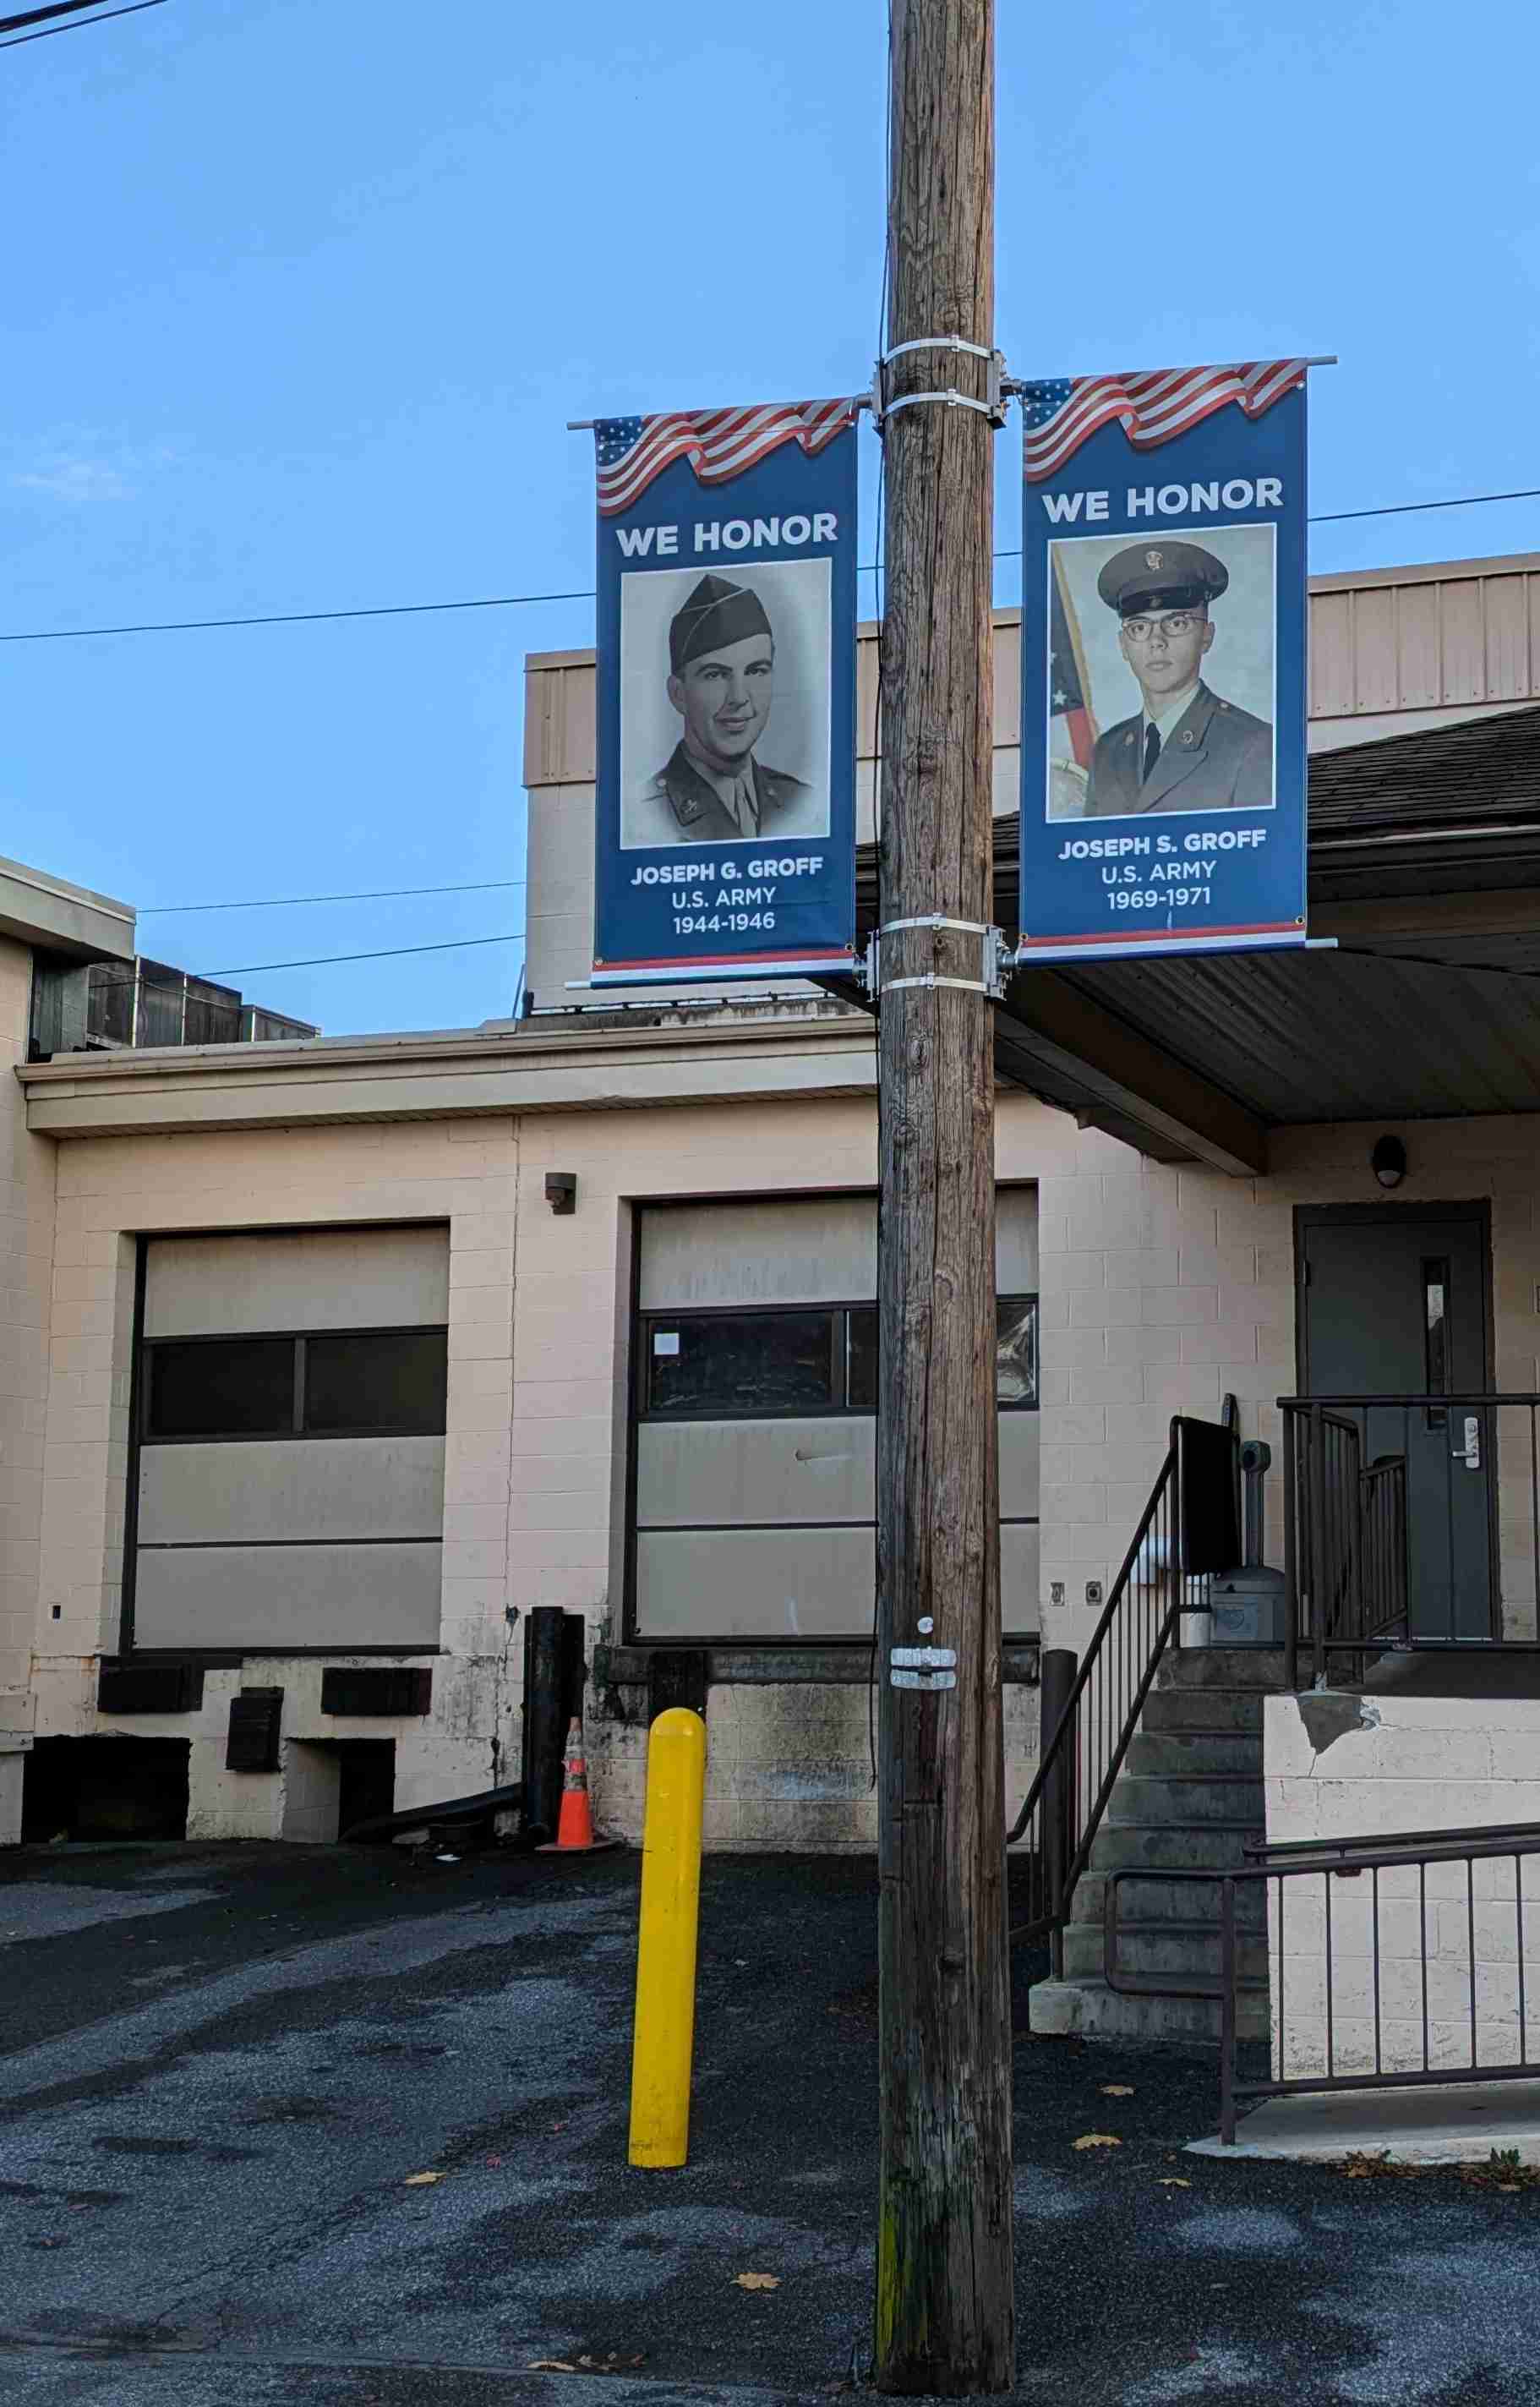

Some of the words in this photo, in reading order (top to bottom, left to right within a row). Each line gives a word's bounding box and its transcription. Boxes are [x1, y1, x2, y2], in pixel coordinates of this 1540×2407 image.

[1041, 490, 1110, 522] WE
[1127, 477, 1284, 517] HONOR
[615, 525, 679, 556] WE
[694, 512, 838, 552] HONOR
[1058, 835, 1150, 860] JOSEPH
[1155, 834, 1177, 854] S.
[1183, 829, 1267, 851] GROFF
[631, 862, 714, 885] JOSEPH
[720, 862, 742, 879] G.
[747, 856, 823, 878] GROFF
[1101, 865, 1142, 884] U.S.
[1149, 859, 1217, 881] ARMY
[672, 891, 709, 909] U.S.
[715, 886, 777, 907] ARMY
[1106, 886, 1211, 910] 1969-1971
[673, 911, 775, 934] 1944-1946
